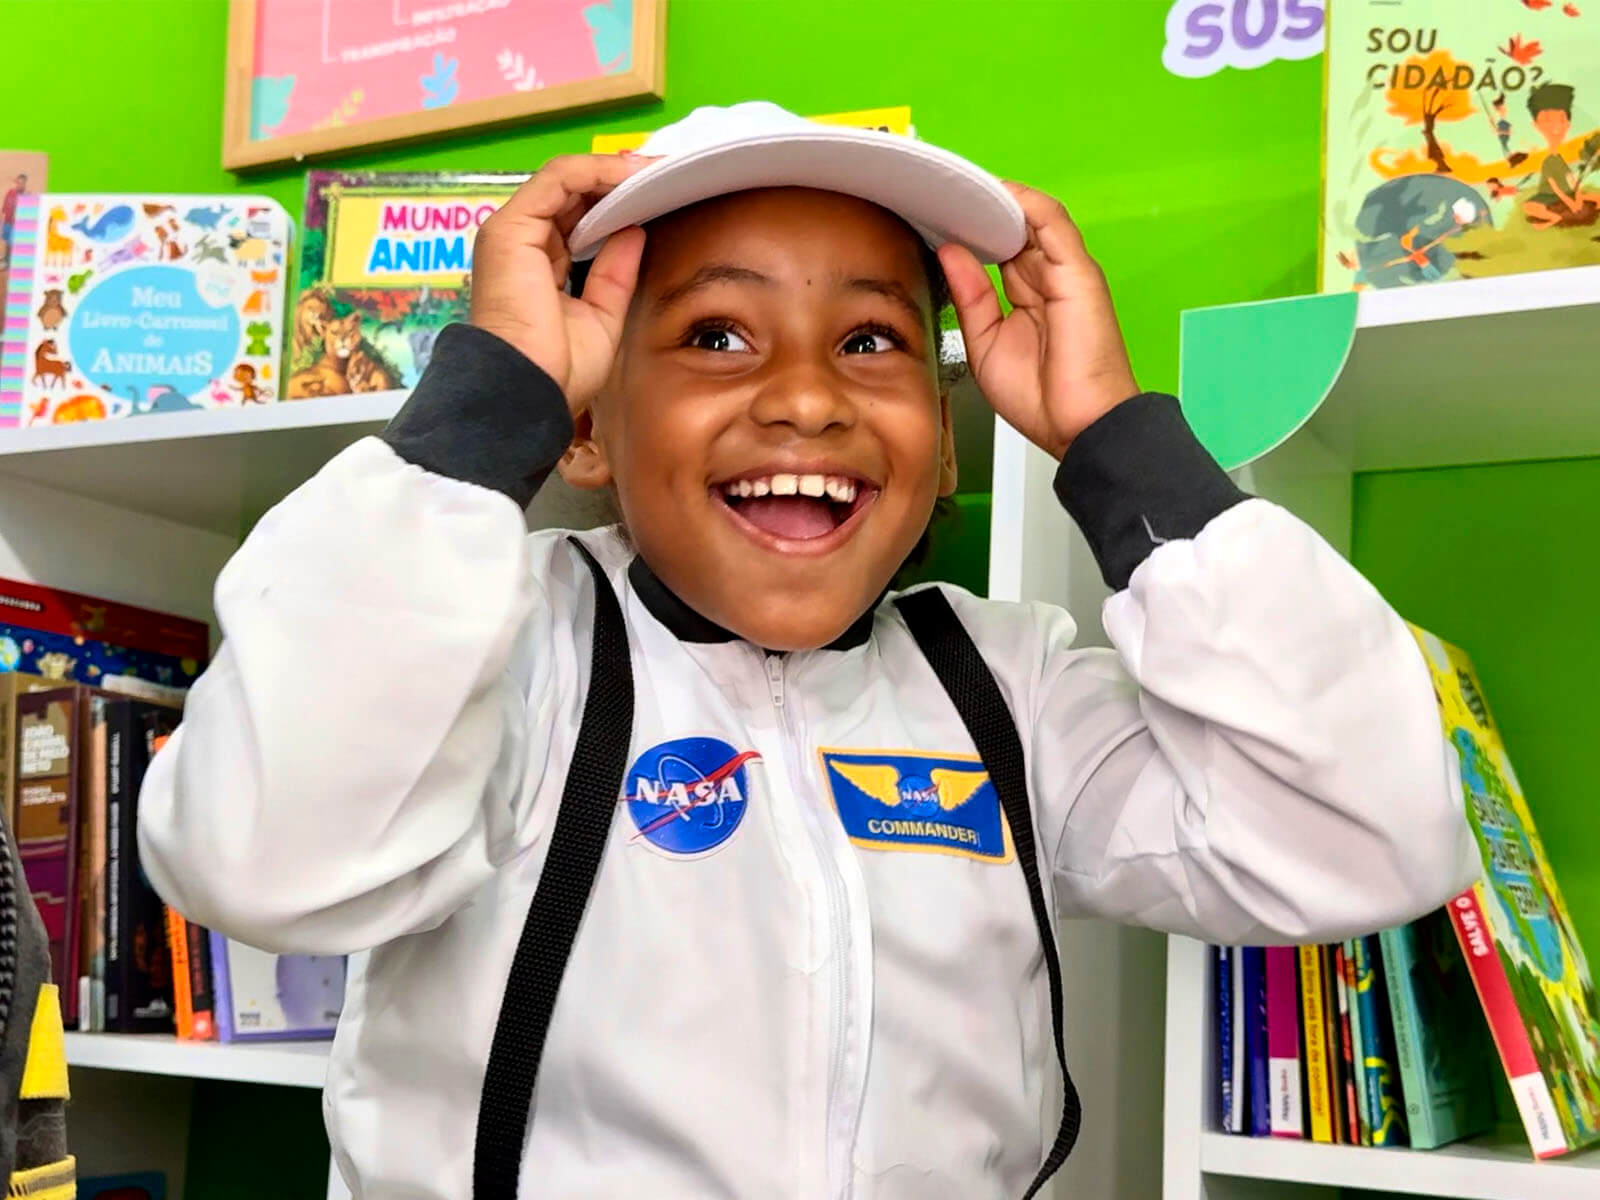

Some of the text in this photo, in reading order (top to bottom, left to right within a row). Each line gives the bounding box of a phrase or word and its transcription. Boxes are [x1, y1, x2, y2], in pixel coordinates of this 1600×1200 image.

[1366, 27, 1439, 54] SOU
[1367, 58, 1544, 92] CIDADÃO?
[368, 236, 473, 273] ANIM
[132, 285, 182, 308] Meu
[143, 334, 164, 347] de
[635, 775, 743, 808] NASA
[901, 787, 939, 804] NASA
[867, 818, 979, 845] COMMANDER
[1460, 908, 1489, 957] SALVE
